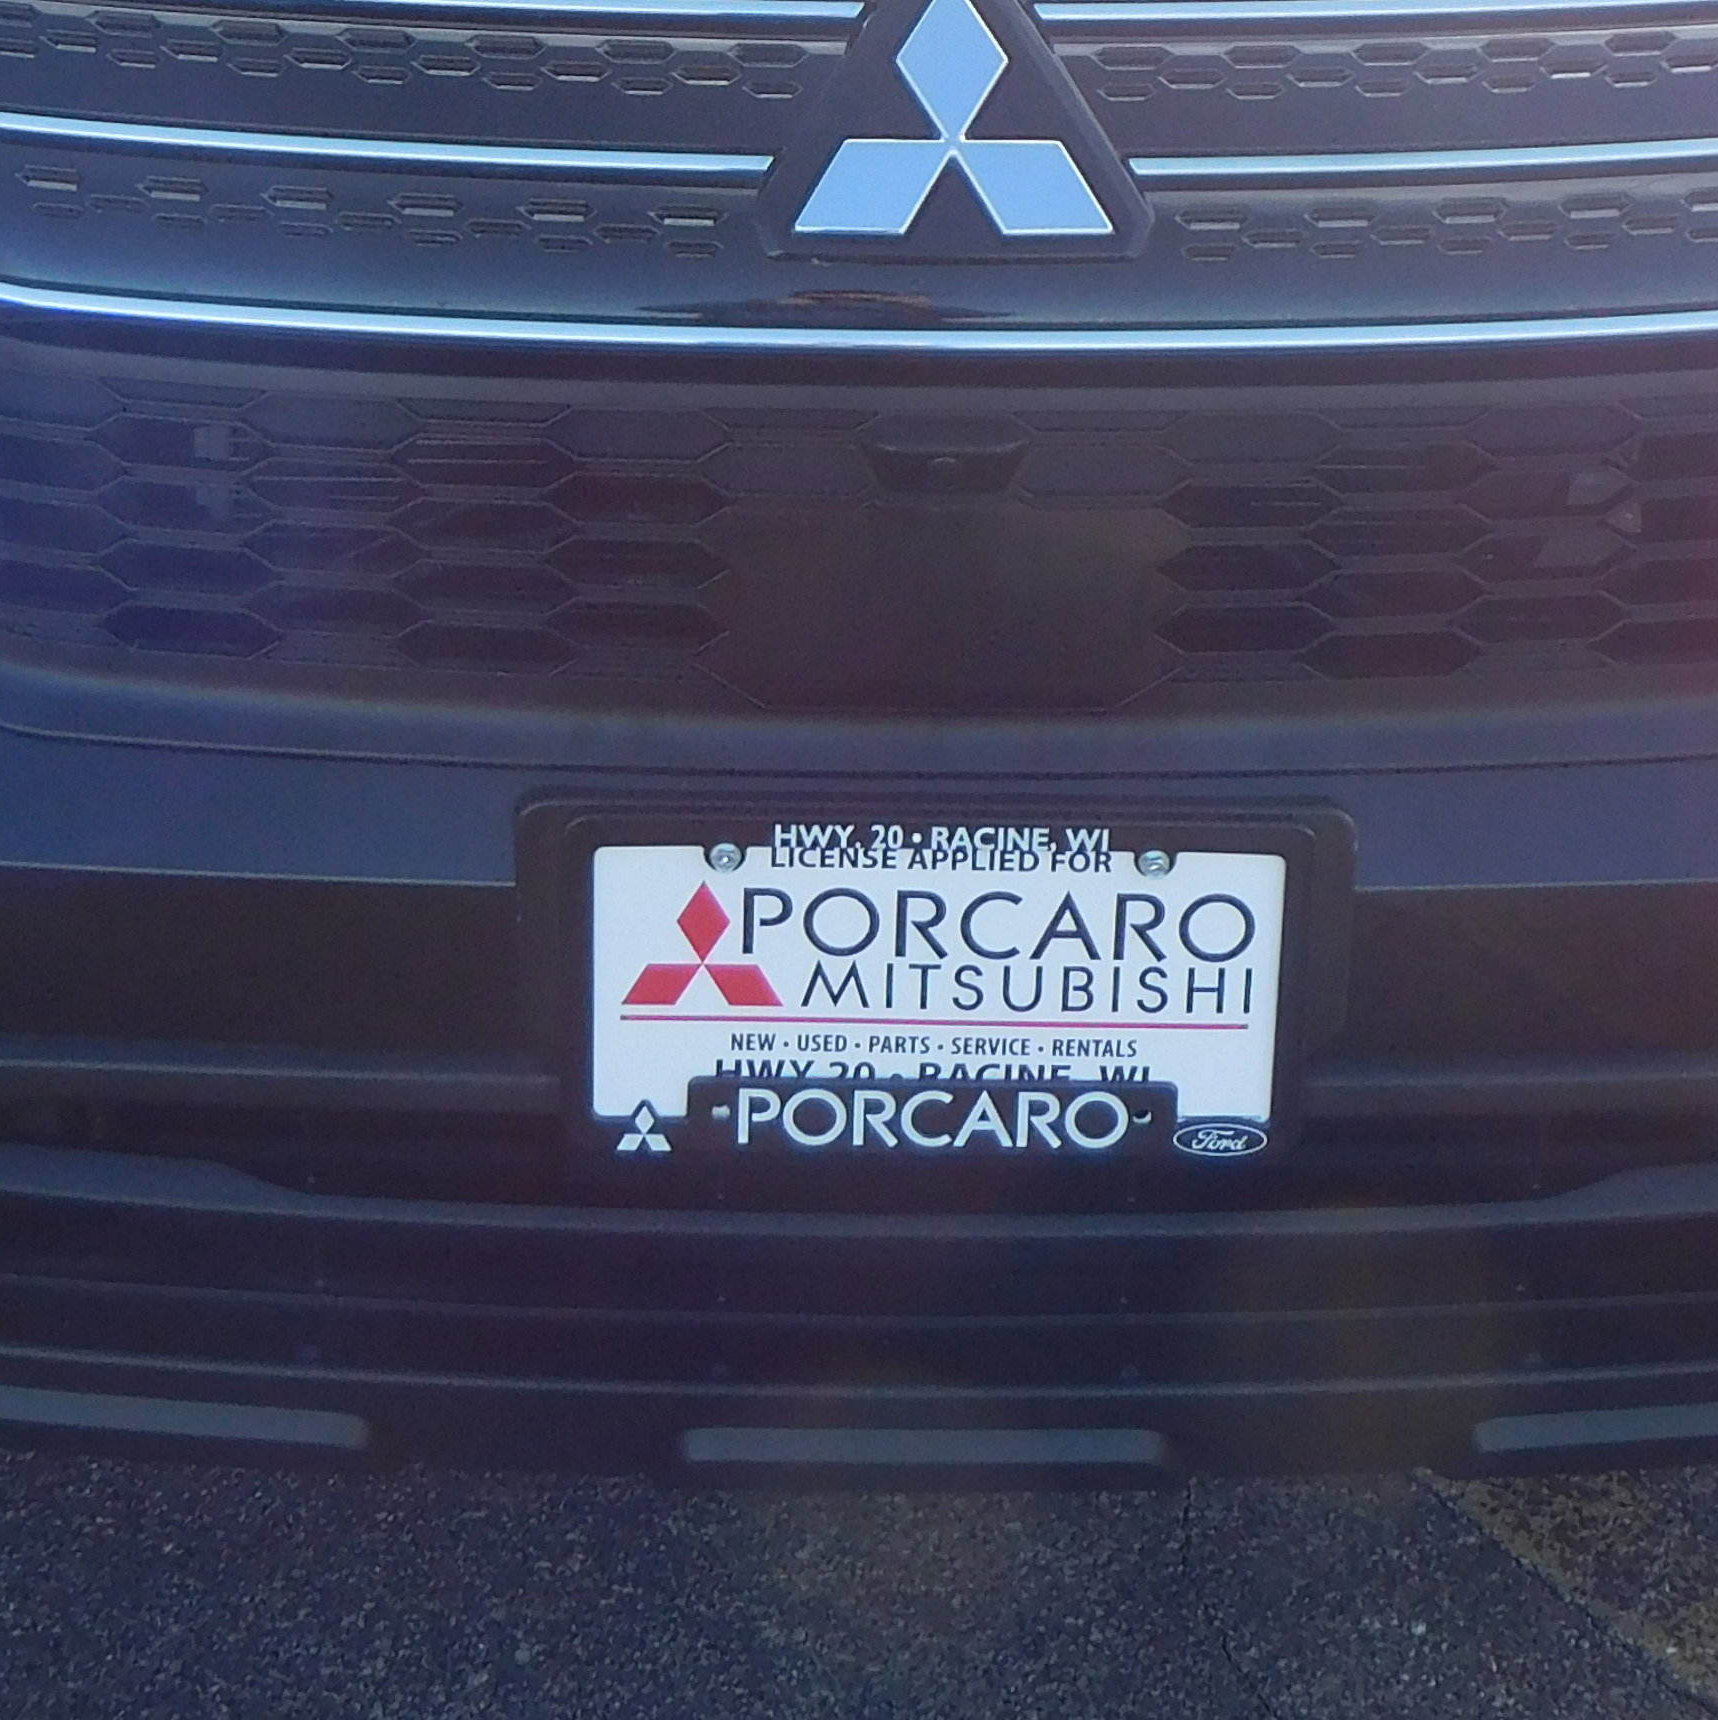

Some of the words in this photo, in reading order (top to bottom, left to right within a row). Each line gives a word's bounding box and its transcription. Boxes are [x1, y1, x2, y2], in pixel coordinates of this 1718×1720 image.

[871, 824, 904, 849] 20
[931, 826, 1057, 854] RACINE,
[1065, 828, 1110, 853] WI
[771, 847, 897, 869] LICENSE
[907, 848, 1040, 872] APPLIED
[1051, 850, 1112, 873] FOR
[742, 886, 1256, 962] PORCARO
[801, 960, 1253, 1013] MITSUBISHI
[730, 1033, 776, 1051] NEW
[797, 1034, 848, 1052] USED
[868, 1035, 931, 1055] PARTS
[950, 1037, 1031, 1056] SERVICE
[1051, 1039, 1138, 1058] RENTALS
[736, 1087, 1129, 1149] PORCARO
[1191, 1129, 1249, 1151] Ford
